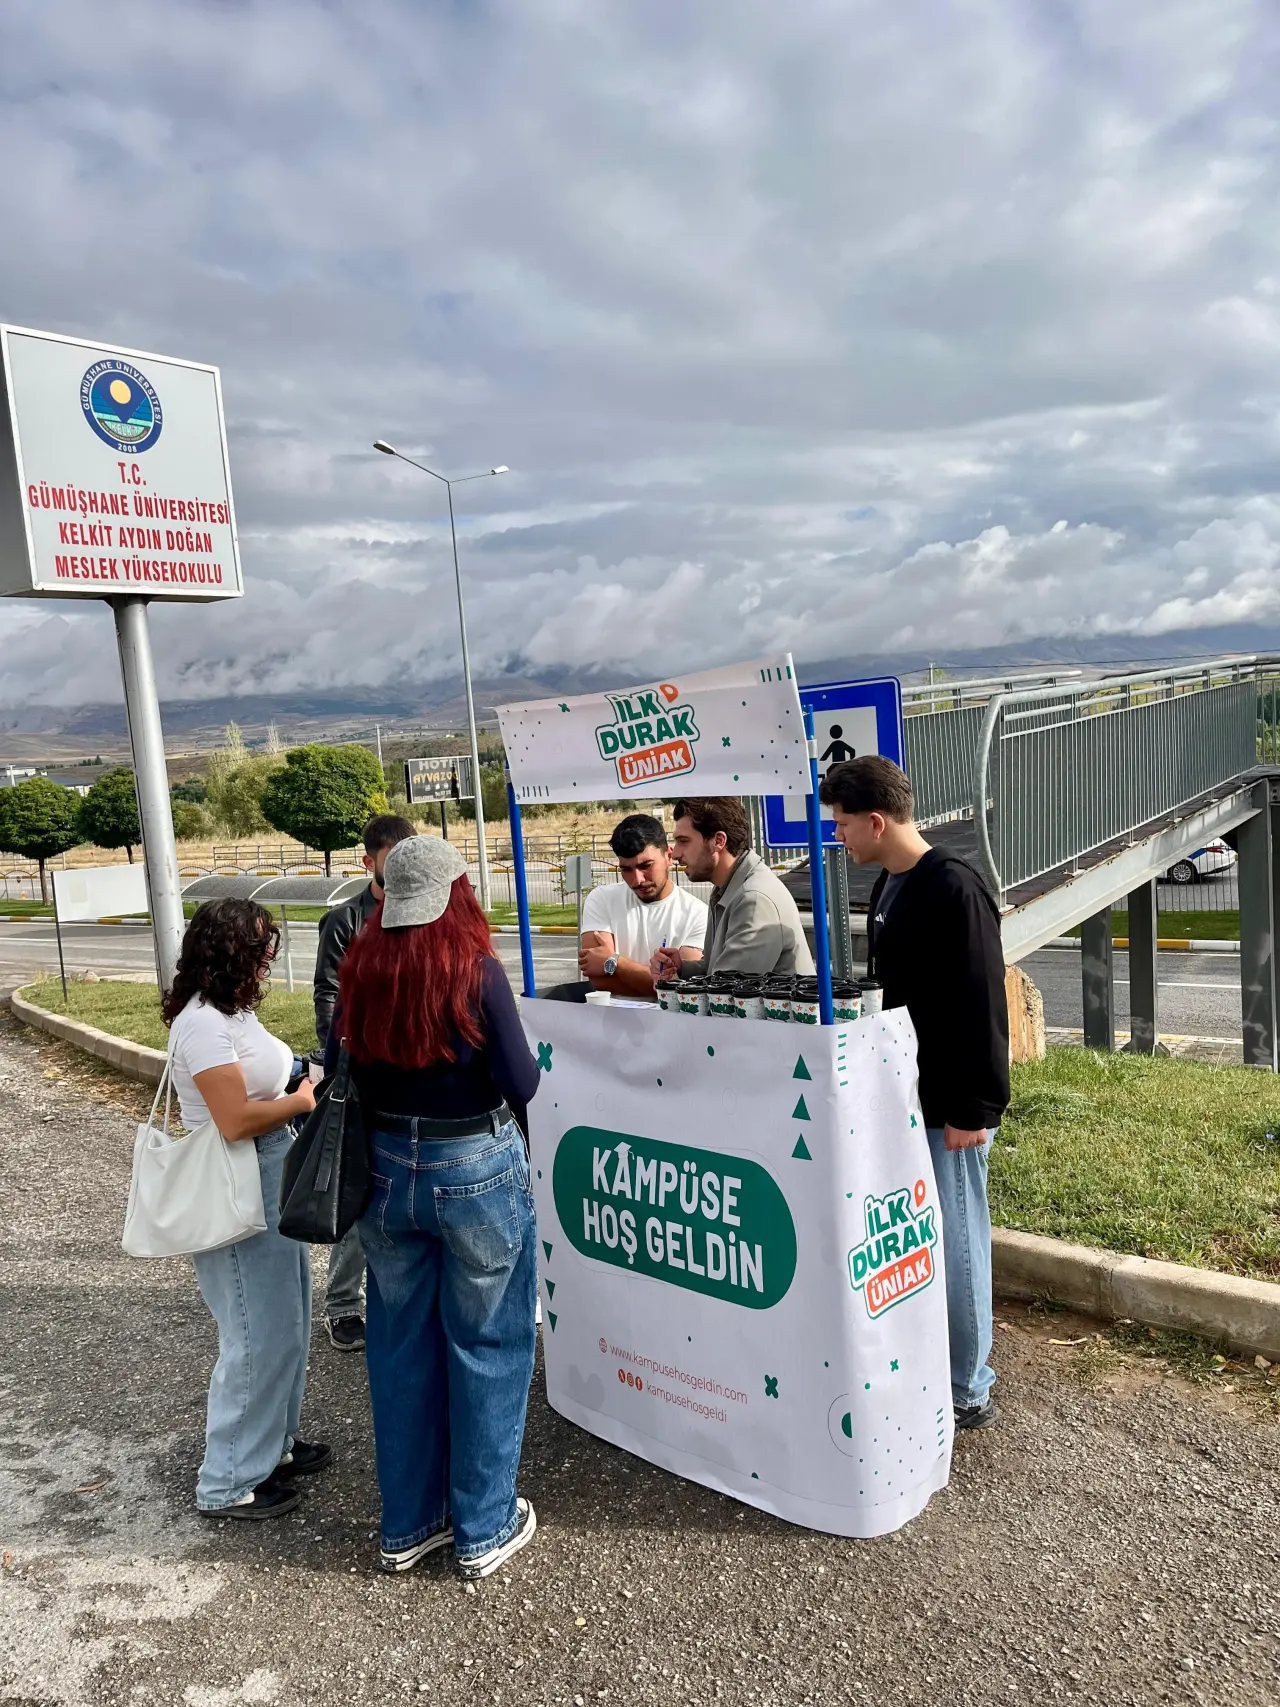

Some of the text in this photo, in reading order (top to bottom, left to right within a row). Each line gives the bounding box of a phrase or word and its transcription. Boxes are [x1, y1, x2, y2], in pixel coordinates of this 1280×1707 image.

[117, 443, 138, 453] 2008
[117, 462, 147, 486] T.C.
[28, 481, 230, 525] GÜMÜŞHANE ÜNİVERSİTESİ
[58, 520, 213, 553] KELKİT AYDIN DOĞAN
[55, 555, 223, 584] MESLEK YÜKSEKOKULU
[611, 692, 661, 723] İLK
[599, 711, 695, 755] DURAK
[623, 747, 688, 781] ÜNİAK
[592, 1143, 742, 1228] KAMPÜSE
[582, 1197, 638, 1265] HOŞ
[866, 1195, 909, 1238] İLK
[852, 1213, 934, 1282] DURAK
[870, 1255, 929, 1307] ÜNİAK
[609, 1344, 748, 1404] www.kampusehosgeldin.com
[646, 1380, 727, 1423] kampusehosgeldi
